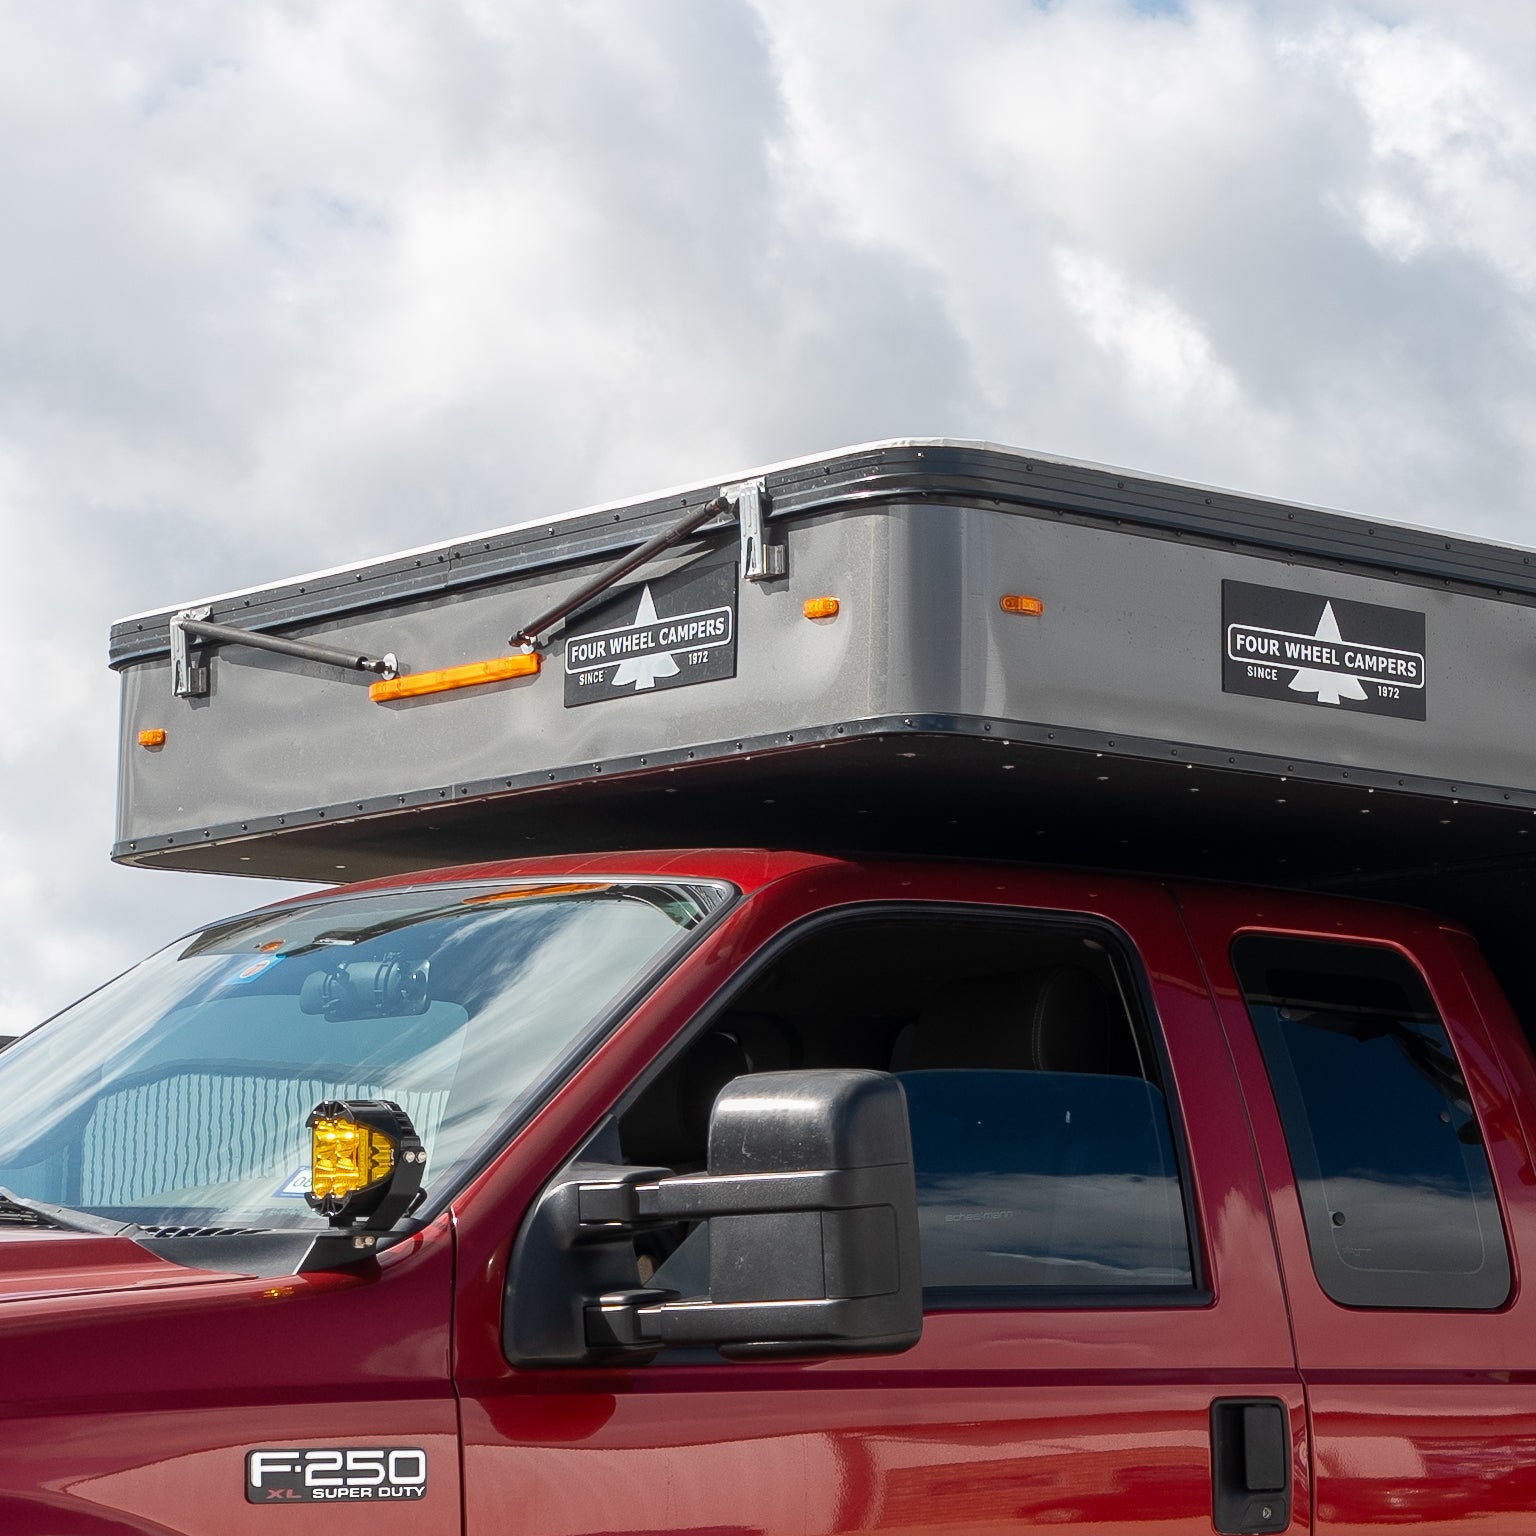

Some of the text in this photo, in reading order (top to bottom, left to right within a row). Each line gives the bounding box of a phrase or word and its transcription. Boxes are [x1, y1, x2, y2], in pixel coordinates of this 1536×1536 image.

[571, 617, 725, 663] FOUR WHEEL CAMPERS
[1236, 633, 1417, 678] FOUR WHEEL CAMPERS
[579, 651, 709, 686] SINCE 1972
[1246, 665, 1400, 699] SINCE 1972
[265, 1486, 425, 1499] XL SUPER DUTY
